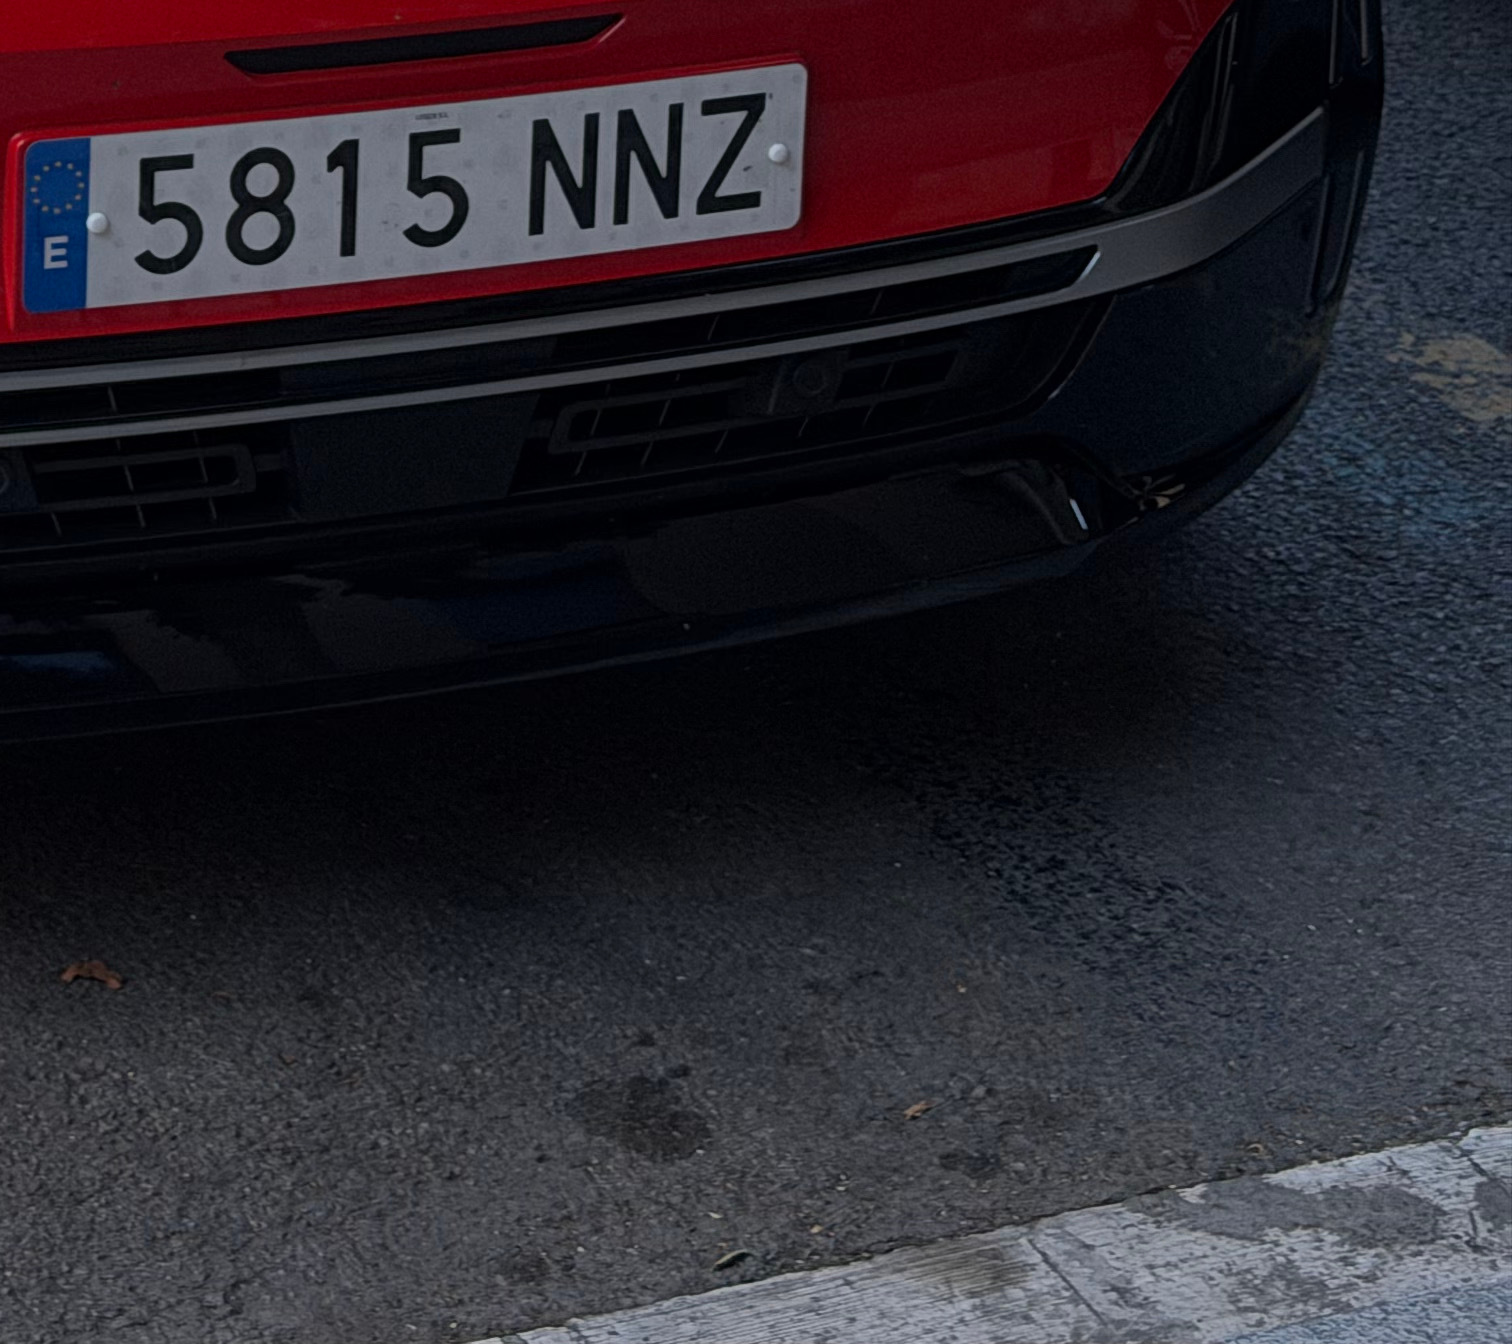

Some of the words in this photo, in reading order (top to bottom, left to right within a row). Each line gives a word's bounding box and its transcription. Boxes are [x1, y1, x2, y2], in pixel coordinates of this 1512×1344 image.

[134, 127, 470, 275] 5815
[528, 92, 767, 237] NNZ
[43, 235, 69, 270] E
